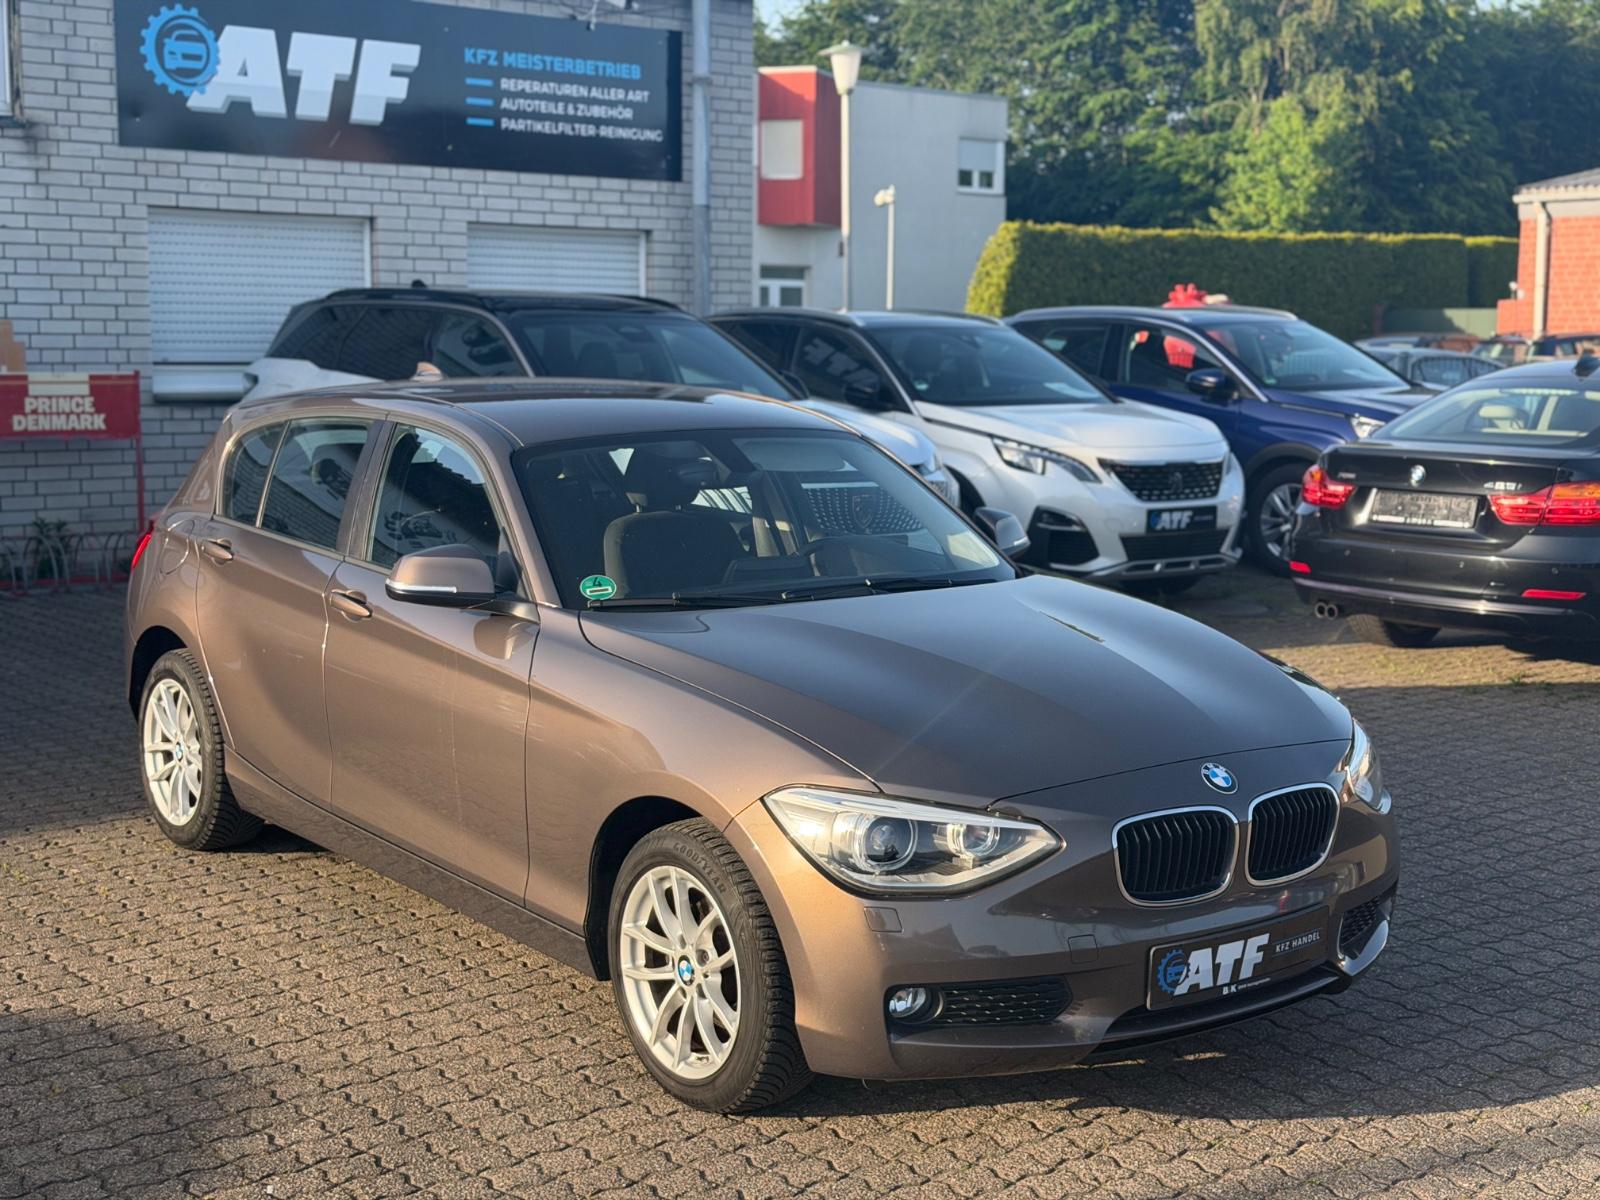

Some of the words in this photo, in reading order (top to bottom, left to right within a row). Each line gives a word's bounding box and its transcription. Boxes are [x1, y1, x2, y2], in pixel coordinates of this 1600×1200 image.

[185, 25, 421, 126] ATF
[463, 47, 498, 66] KFZ
[502, 51, 642, 80] MEISTERBETRIEB
[500, 77, 589, 98] REPERATUREN
[589, 86, 626, 101] ALLER
[626, 89, 650, 103] ART
[500, 97, 565, 115] AUTOTEILE
[566, 103, 575, 116] &
[576, 103, 634, 120] ZUBEHÖR
[500, 117, 663, 143] PARTIKELFILTER-REINIGUNG
[24, 396, 96, 413] PRINCE
[12, 413, 107, 431] DENMARK
[1155, 510, 1193, 530] ATF
[592, 577, 602, 587] 4
[1173, 933, 1270, 996] ATF
[1275, 941, 1291, 953] KFZ
[1291, 930, 1321, 949] HANDEL
